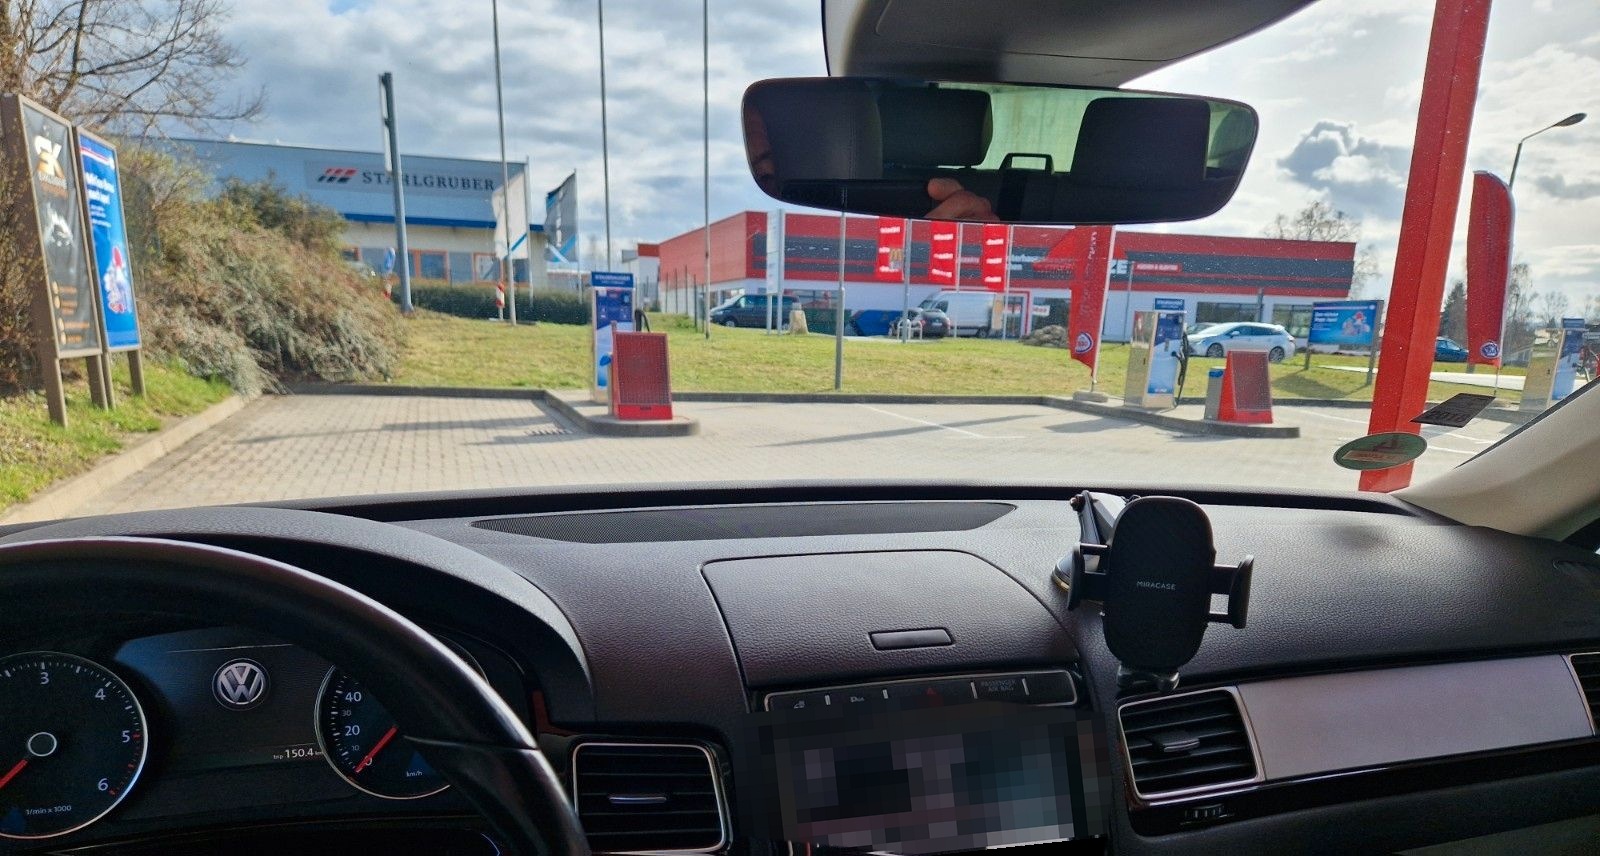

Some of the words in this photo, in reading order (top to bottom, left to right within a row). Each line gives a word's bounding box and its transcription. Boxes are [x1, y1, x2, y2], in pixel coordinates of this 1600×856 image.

[1136, 581, 1176, 590] MIRACASE
[40, 672, 49, 684] 3
[95, 688, 106, 700] 4
[345, 691, 362, 702] 40
[344, 725, 360, 736] 20
[122, 730, 130, 743] 5
[285, 748, 314, 758] 150.4
[98, 778, 108, 791] 6
